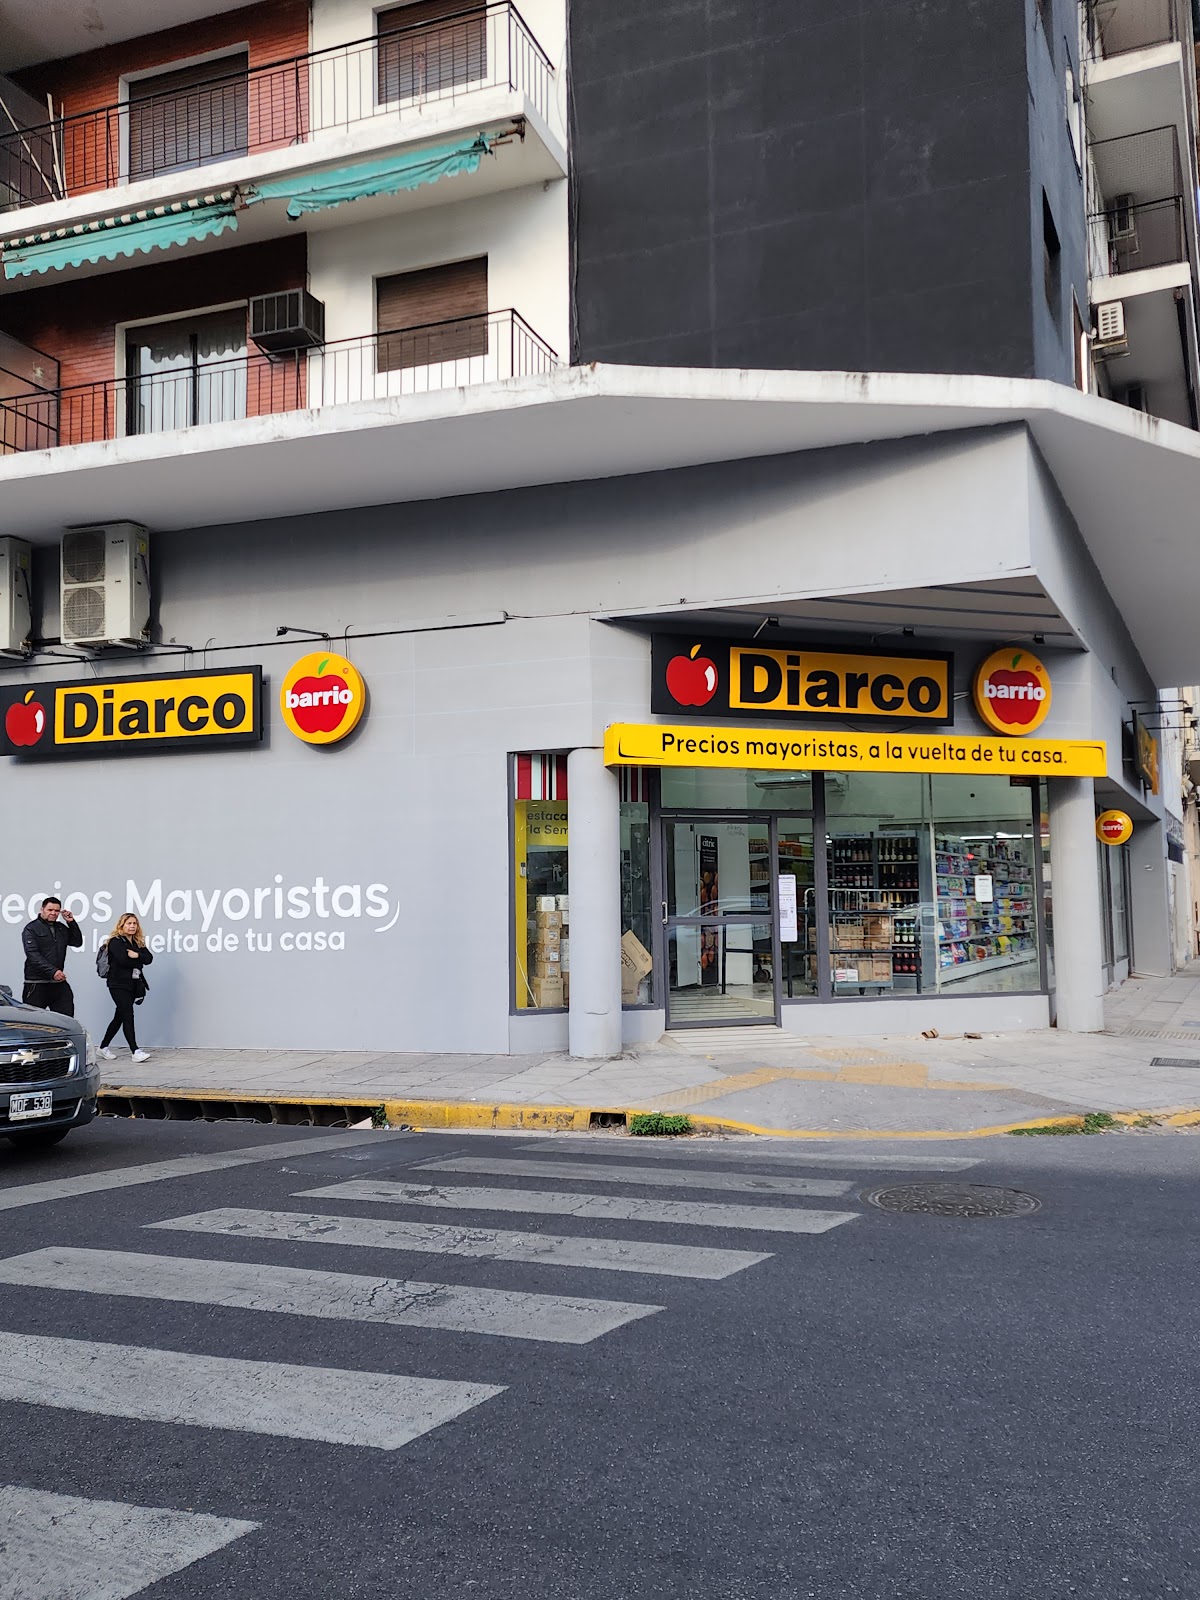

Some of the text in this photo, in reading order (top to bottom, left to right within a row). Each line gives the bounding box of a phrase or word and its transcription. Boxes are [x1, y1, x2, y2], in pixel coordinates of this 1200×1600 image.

[739, 653, 942, 714] Diarco
[984, 680, 1046, 701] barrio
[285, 685, 353, 709] barrio
[63, 688, 247, 739] Diarco
[662, 733, 1068, 764] Precios mayoristas, a la vuelta de tu casa.
[1102, 822, 1124, 831] barrio
[126, 874, 390, 932] Mayoristas
[206, 927, 239, 953] de
[245, 928, 273, 952] tu
[279, 930, 345, 951] casa
[34, 1097, 51, 1109] 538
